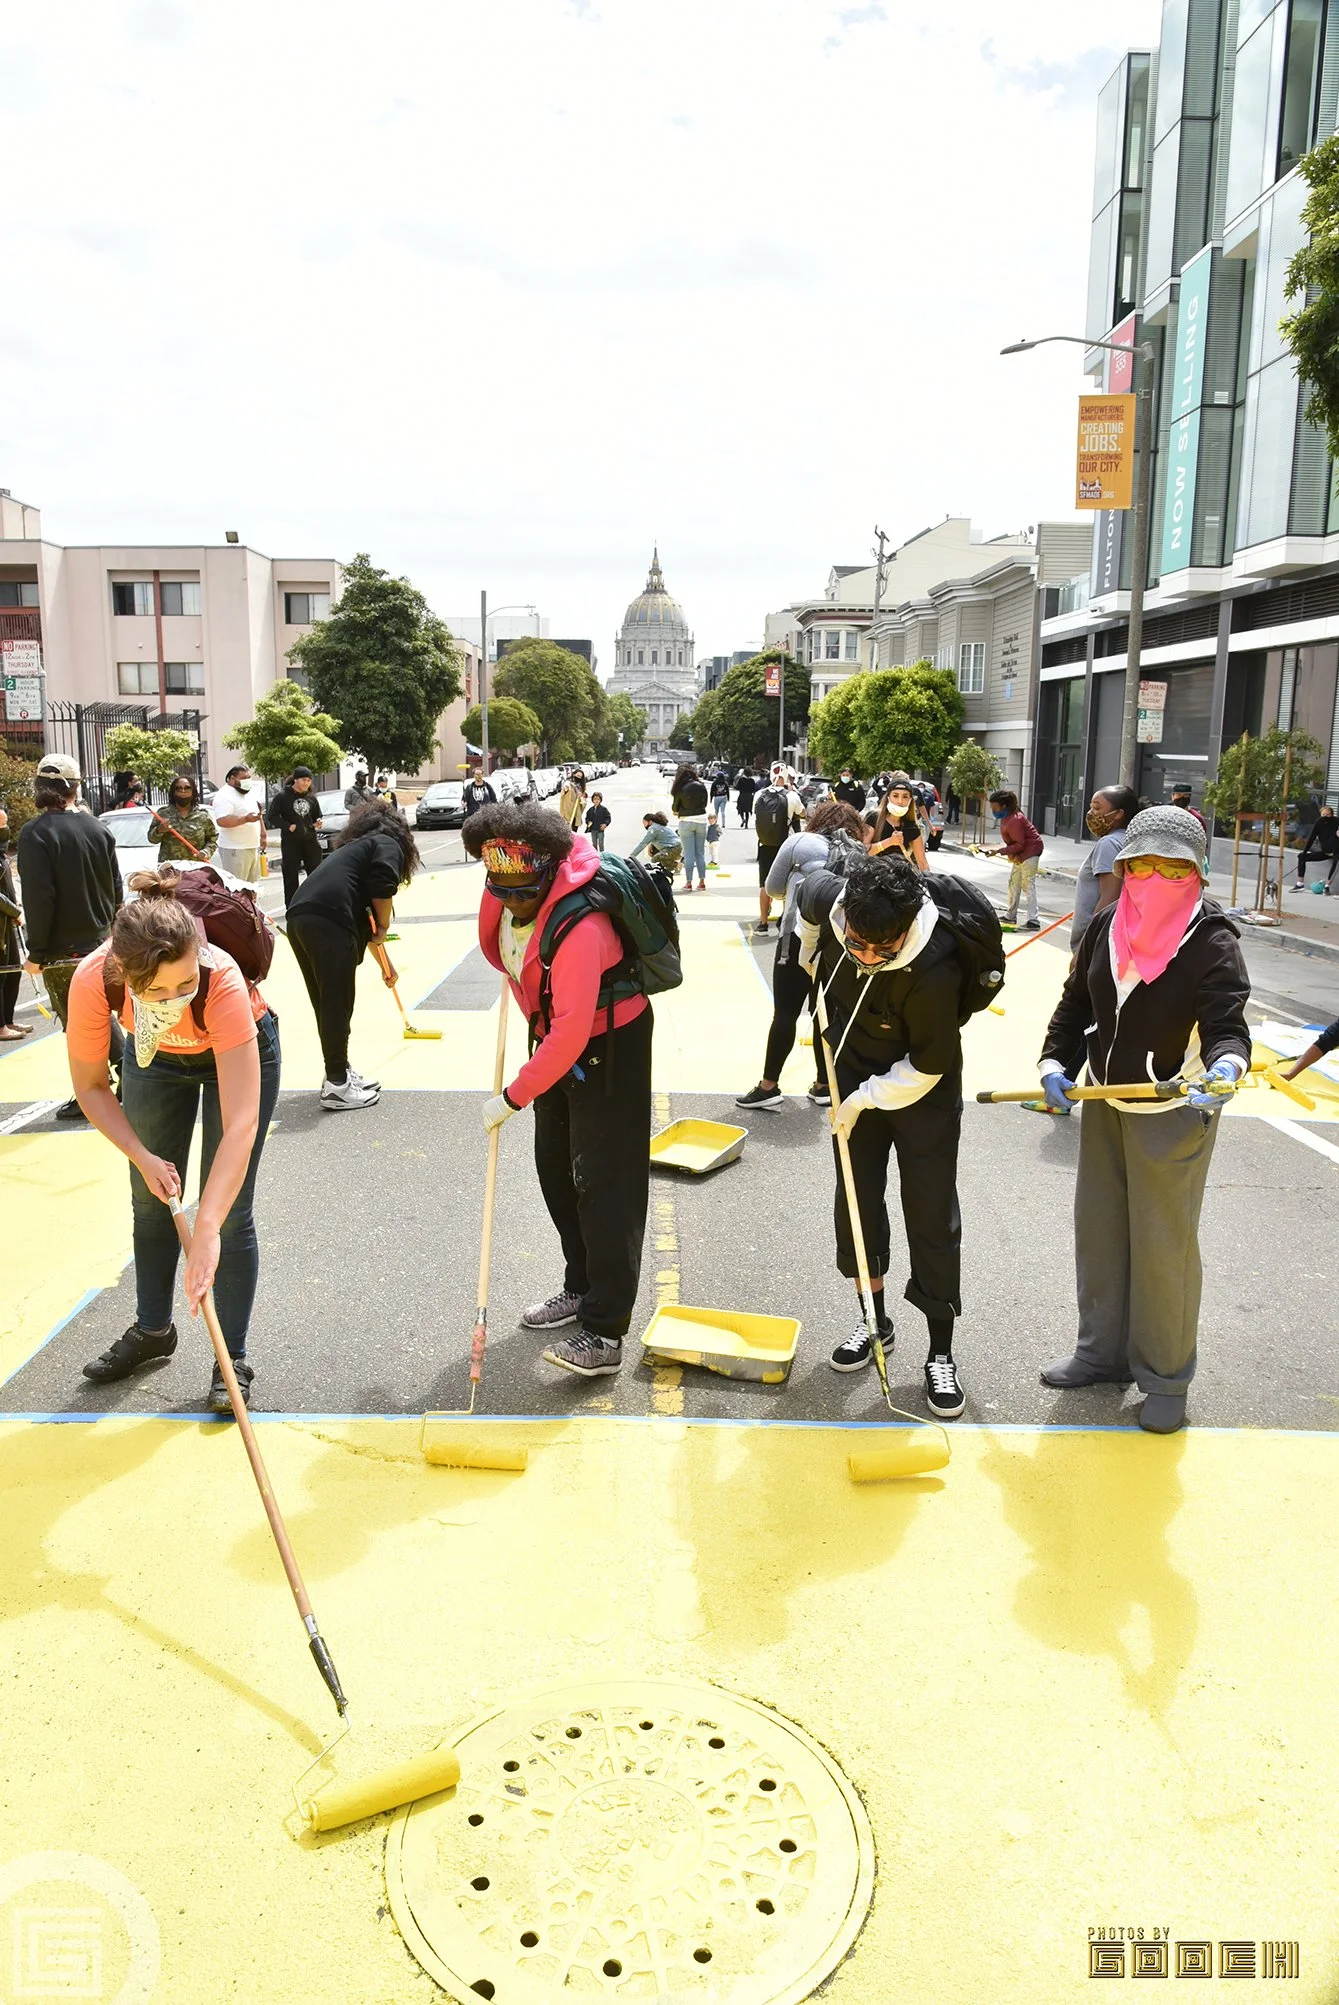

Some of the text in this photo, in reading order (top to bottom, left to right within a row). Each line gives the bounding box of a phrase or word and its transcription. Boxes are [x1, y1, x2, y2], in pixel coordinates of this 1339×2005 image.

[1080, 405, 1124, 414] EMPOWERING
[1170, 295, 1199, 549] NOW SELLING
[1080, 422, 1124, 434] CREATING
[1080, 434, 1121, 452] JOBS.
[1079, 453, 1123, 461] TRANSFORMING
[1079, 461, 1122, 472] OUR CITY.
[1103, 509, 1115, 588] FULTON
[3, 641, 38, 651] NO PARKING
[7, 680, 14, 690] 2
[1140, 710, 1146, 719] 2
